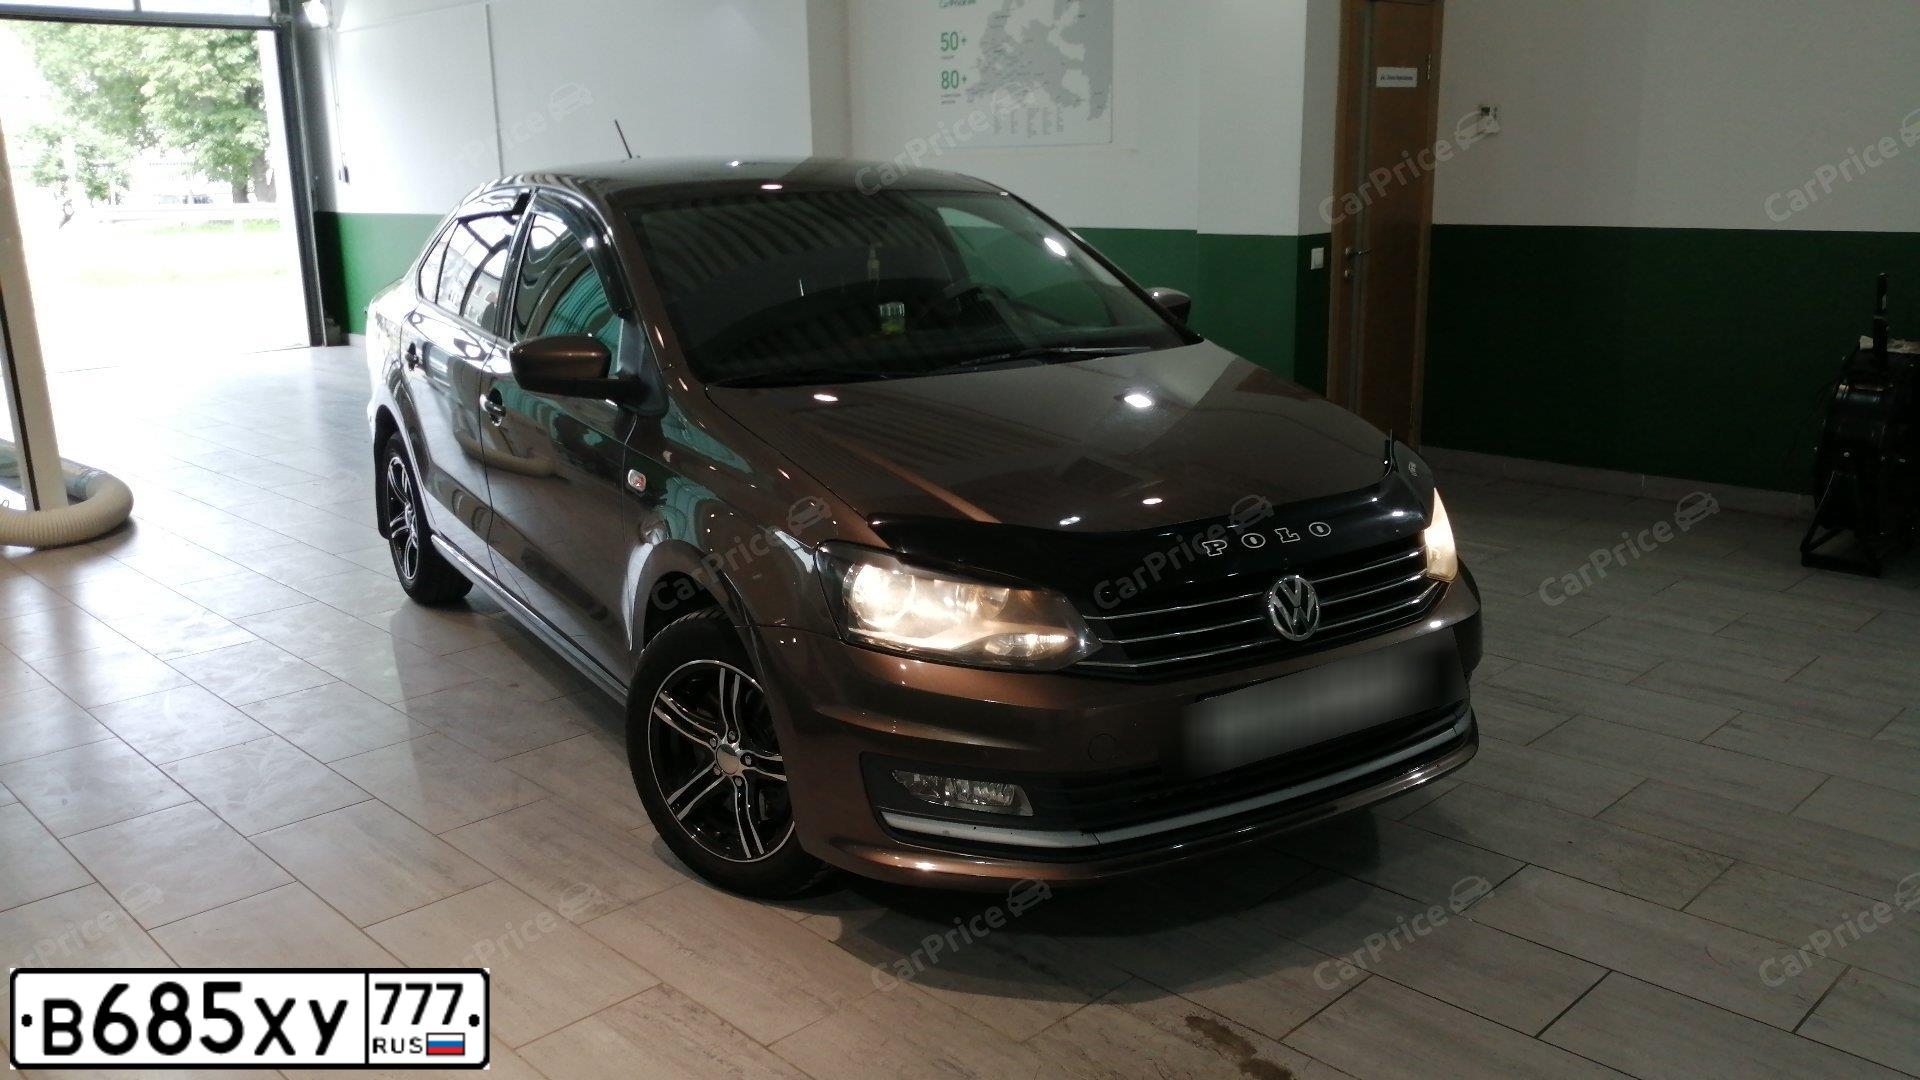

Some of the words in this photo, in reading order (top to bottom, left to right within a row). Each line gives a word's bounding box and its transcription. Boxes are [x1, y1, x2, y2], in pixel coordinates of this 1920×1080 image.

[940, 31, 968, 51] 50+
[941, 70, 968, 90] 80+
[1202, 521, 1332, 557] POLO
